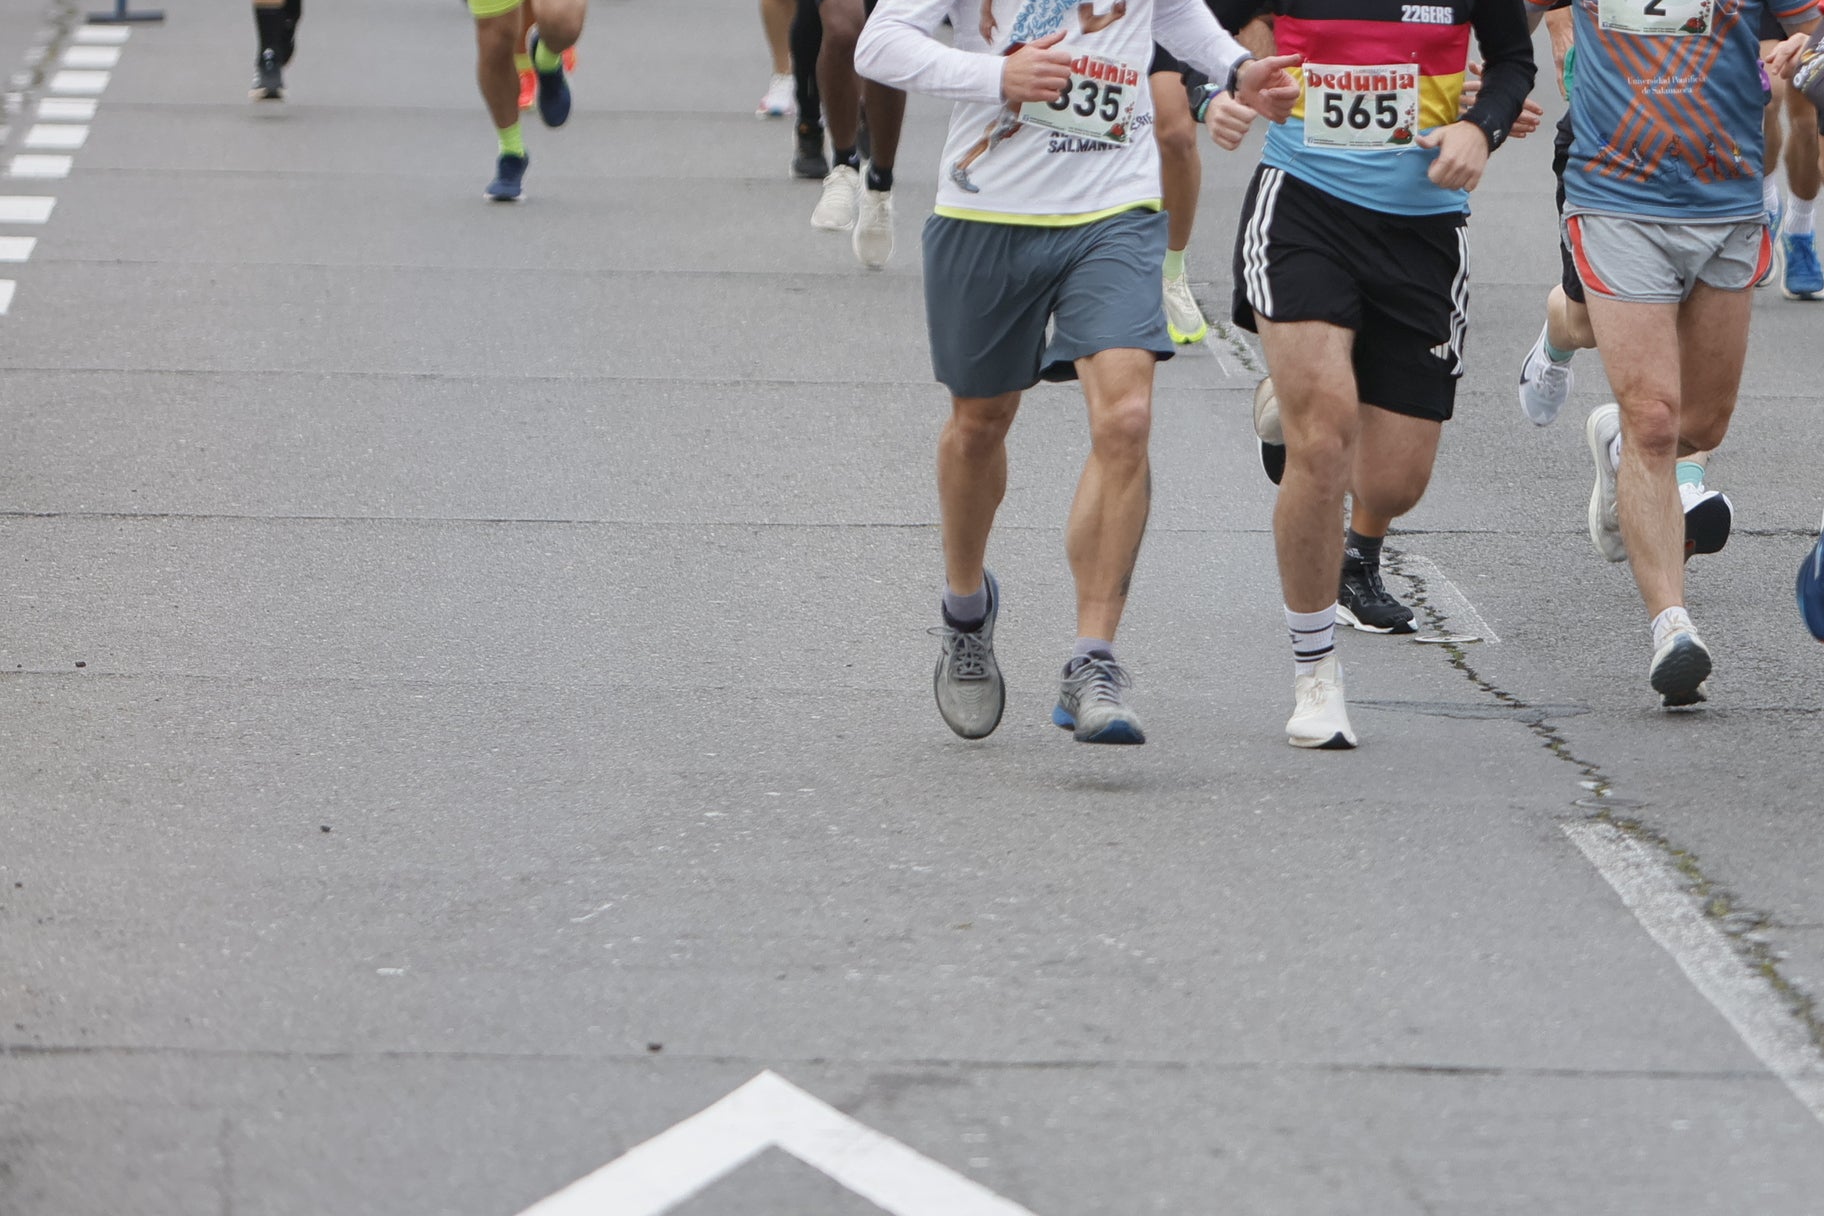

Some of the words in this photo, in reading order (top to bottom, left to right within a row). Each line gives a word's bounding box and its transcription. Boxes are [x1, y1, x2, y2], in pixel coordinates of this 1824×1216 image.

[1402, 5, 1454, 24] 226ERS
[1071, 55, 1138, 86] dunia
[1306, 68, 1415, 92] bedunia
[1323, 92, 1398, 130] 565
